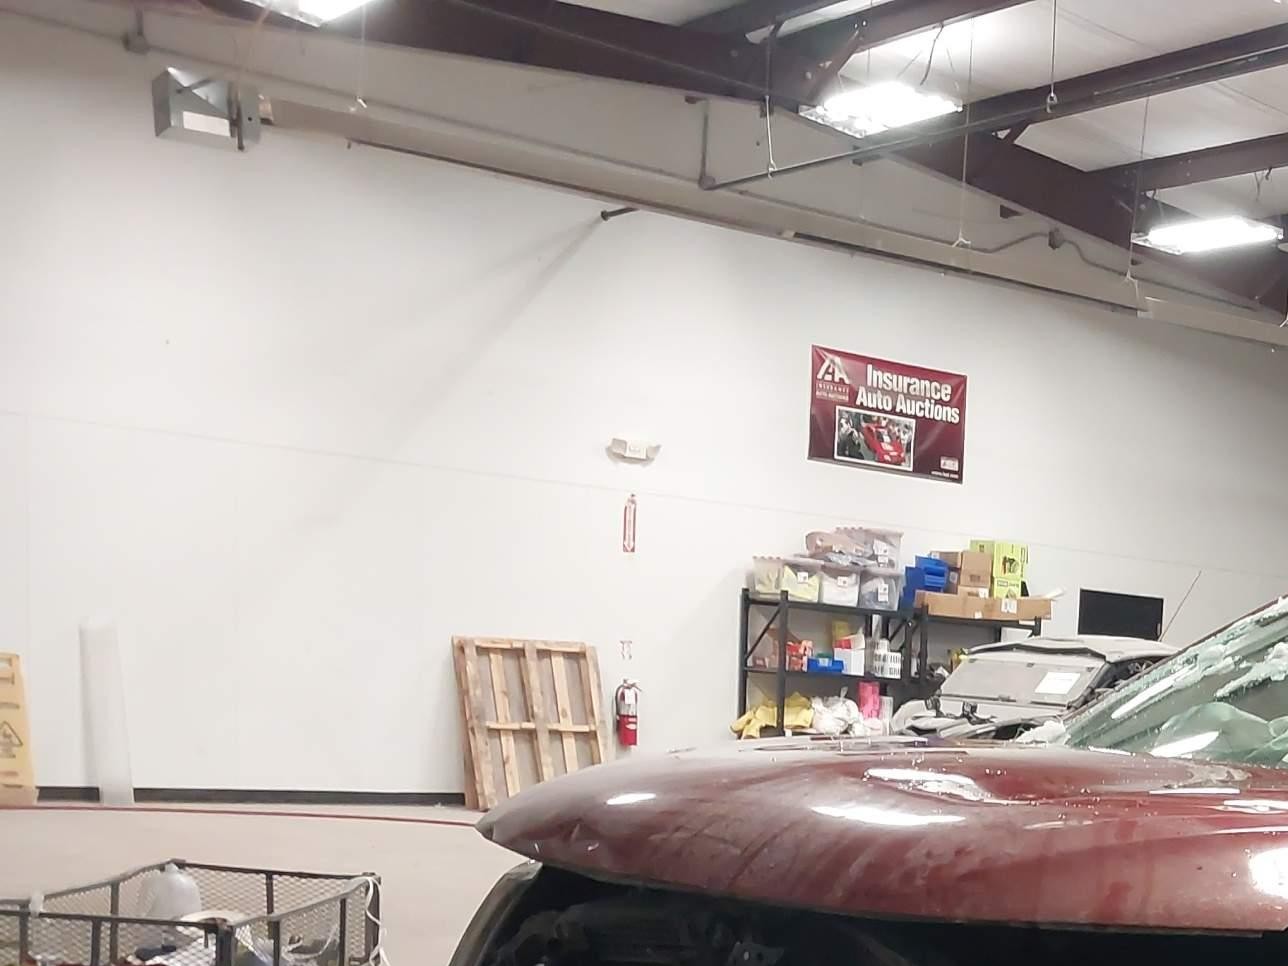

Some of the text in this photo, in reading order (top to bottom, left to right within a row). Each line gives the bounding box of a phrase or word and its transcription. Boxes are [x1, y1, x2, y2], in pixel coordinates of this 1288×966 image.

[867, 364, 952, 402] Insurance
[856, 386, 960, 424] Auto Auctions
